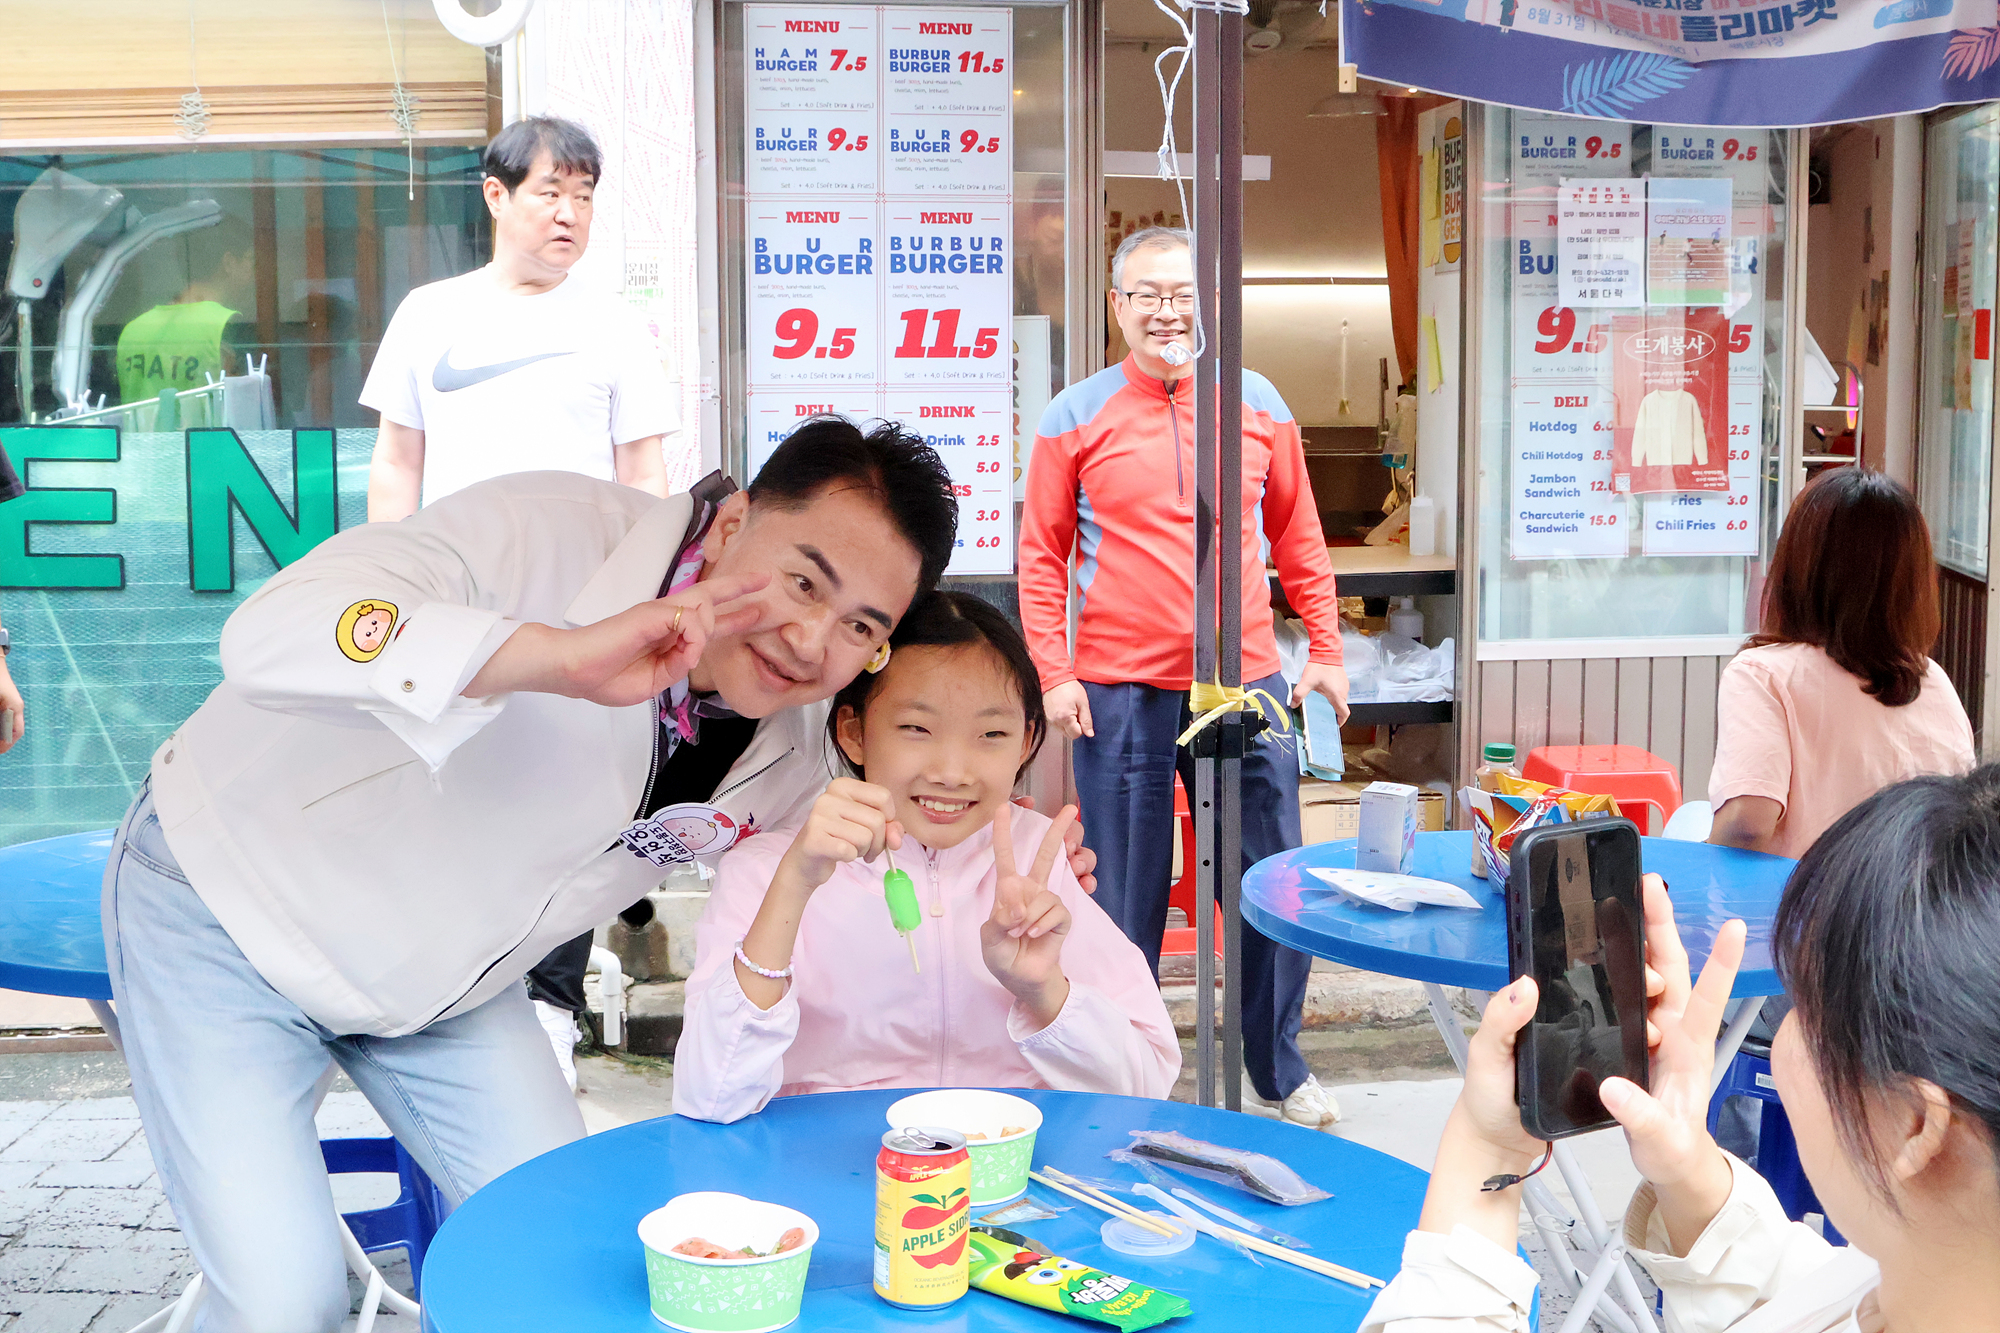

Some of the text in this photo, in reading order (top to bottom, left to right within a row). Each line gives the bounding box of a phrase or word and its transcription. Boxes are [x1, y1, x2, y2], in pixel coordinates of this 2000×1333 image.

[1527, 7, 1550, 25] 8월
[1554, 12, 1586, 31] 31일
[785, 21, 840, 32] MENU
[919, 23, 972, 34] MENU
[756, 50, 867, 71] BURGER 7.5
[890, 50, 950, 60] BURBUR
[890, 52, 1004, 72] BURGER 11.5
[756, 128, 817, 138] BUR
[891, 130, 950, 140] BUR
[756, 128, 868, 151] BURGER 9.5
[891, 130, 999, 153] BURGER 9.5
[1521, 136, 1576, 146] BUR
[1662, 138, 1714, 148] BUR
[1521, 136, 1621, 158] BURGER 9.5
[1662, 139, 1758, 160] BURGER 9.5
[786, 212, 840, 223] MENU
[920, 212, 973, 224] MENU
[755, 238, 872, 253] BUR
[891, 237, 1002, 251] BURBUR
[625, 263, 658, 274] 운시장
[755, 254, 872, 274] BURGER
[891, 254, 1003, 274] BURGER
[628, 275, 659, 286] 리마켓
[773, 308, 856, 359] 9.5
[894, 309, 999, 359] 11.5
[1535, 306, 1608, 354] 9.5
[1634, 335, 1705, 356] 뜨개봉사
[1554, 397, 1588, 407] DELI
[920, 406, 975, 418] DRINK
[1529, 422, 1577, 434] Hotdog
[1730, 425, 1750, 435] 2.5
[927, 434, 1000, 446] Drink 2.5
[1522, 450, 1613, 462] Chili Hotdog 8.5
[1728, 450, 1749, 460] 5.0
[976, 461, 1000, 473] 5.0
[1529, 474, 1576, 484] Jambon
[1525, 488, 1580, 498] Sandwich
[1671, 494, 1748, 506] Fries 3.0
[976, 510, 1000, 521] 3.0
[1520, 510, 1585, 520] Charcuterie
[1526, 515, 1616, 533] Sandwich 15.0
[1656, 520, 1747, 530] Chili Fries 6.0
[976, 536, 1000, 548] 6.0
[649, 827, 688, 855] 도봉구청장
[628, 831, 677, 864] 오언석
[902, 1211, 968, 1252] APPLE SIDR
[1070, 1275, 1133, 1304] 메롱바
